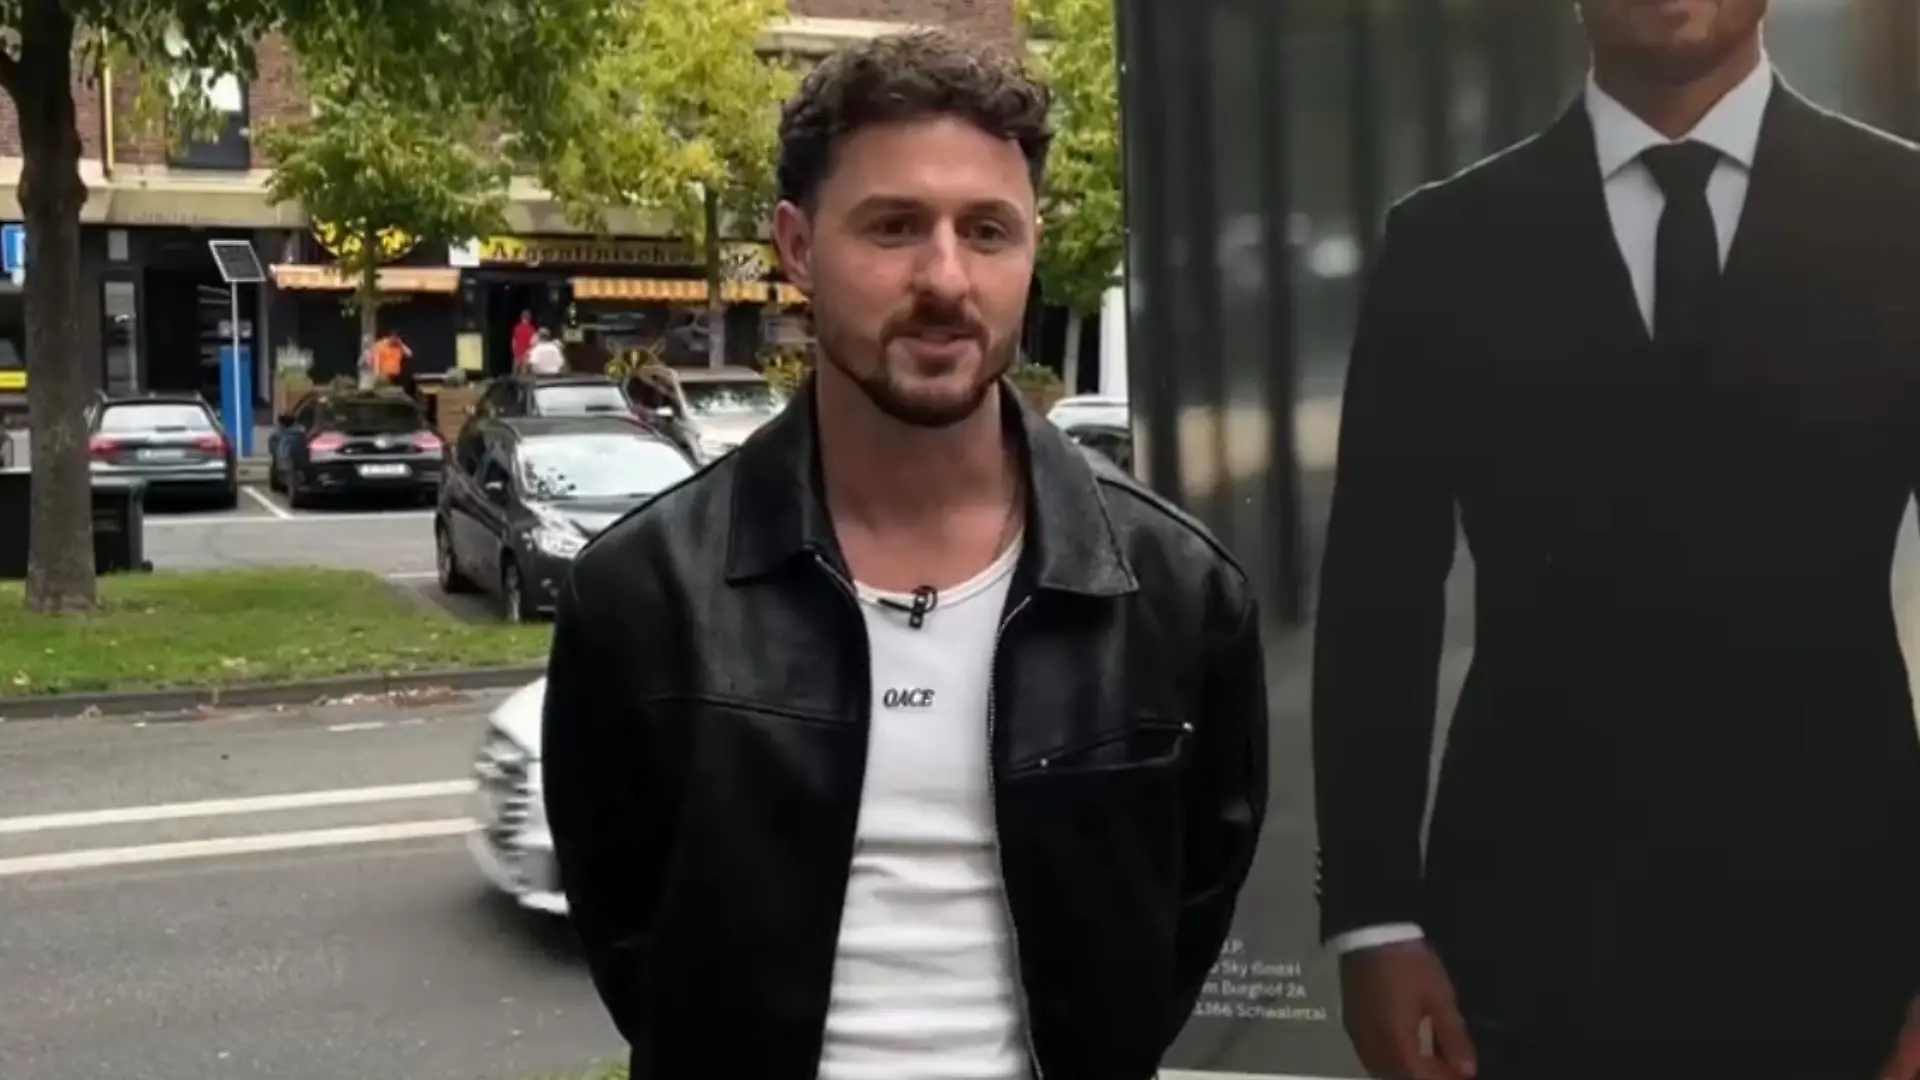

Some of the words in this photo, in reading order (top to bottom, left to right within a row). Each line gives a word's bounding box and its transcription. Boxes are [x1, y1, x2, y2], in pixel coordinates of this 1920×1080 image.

[1221, 959, 1248, 978] Sky
[1222, 979, 1283, 1000] Burghof
[1286, 981, 1308, 998] 2A
[1193, 1001, 1234, 1017] 1366
